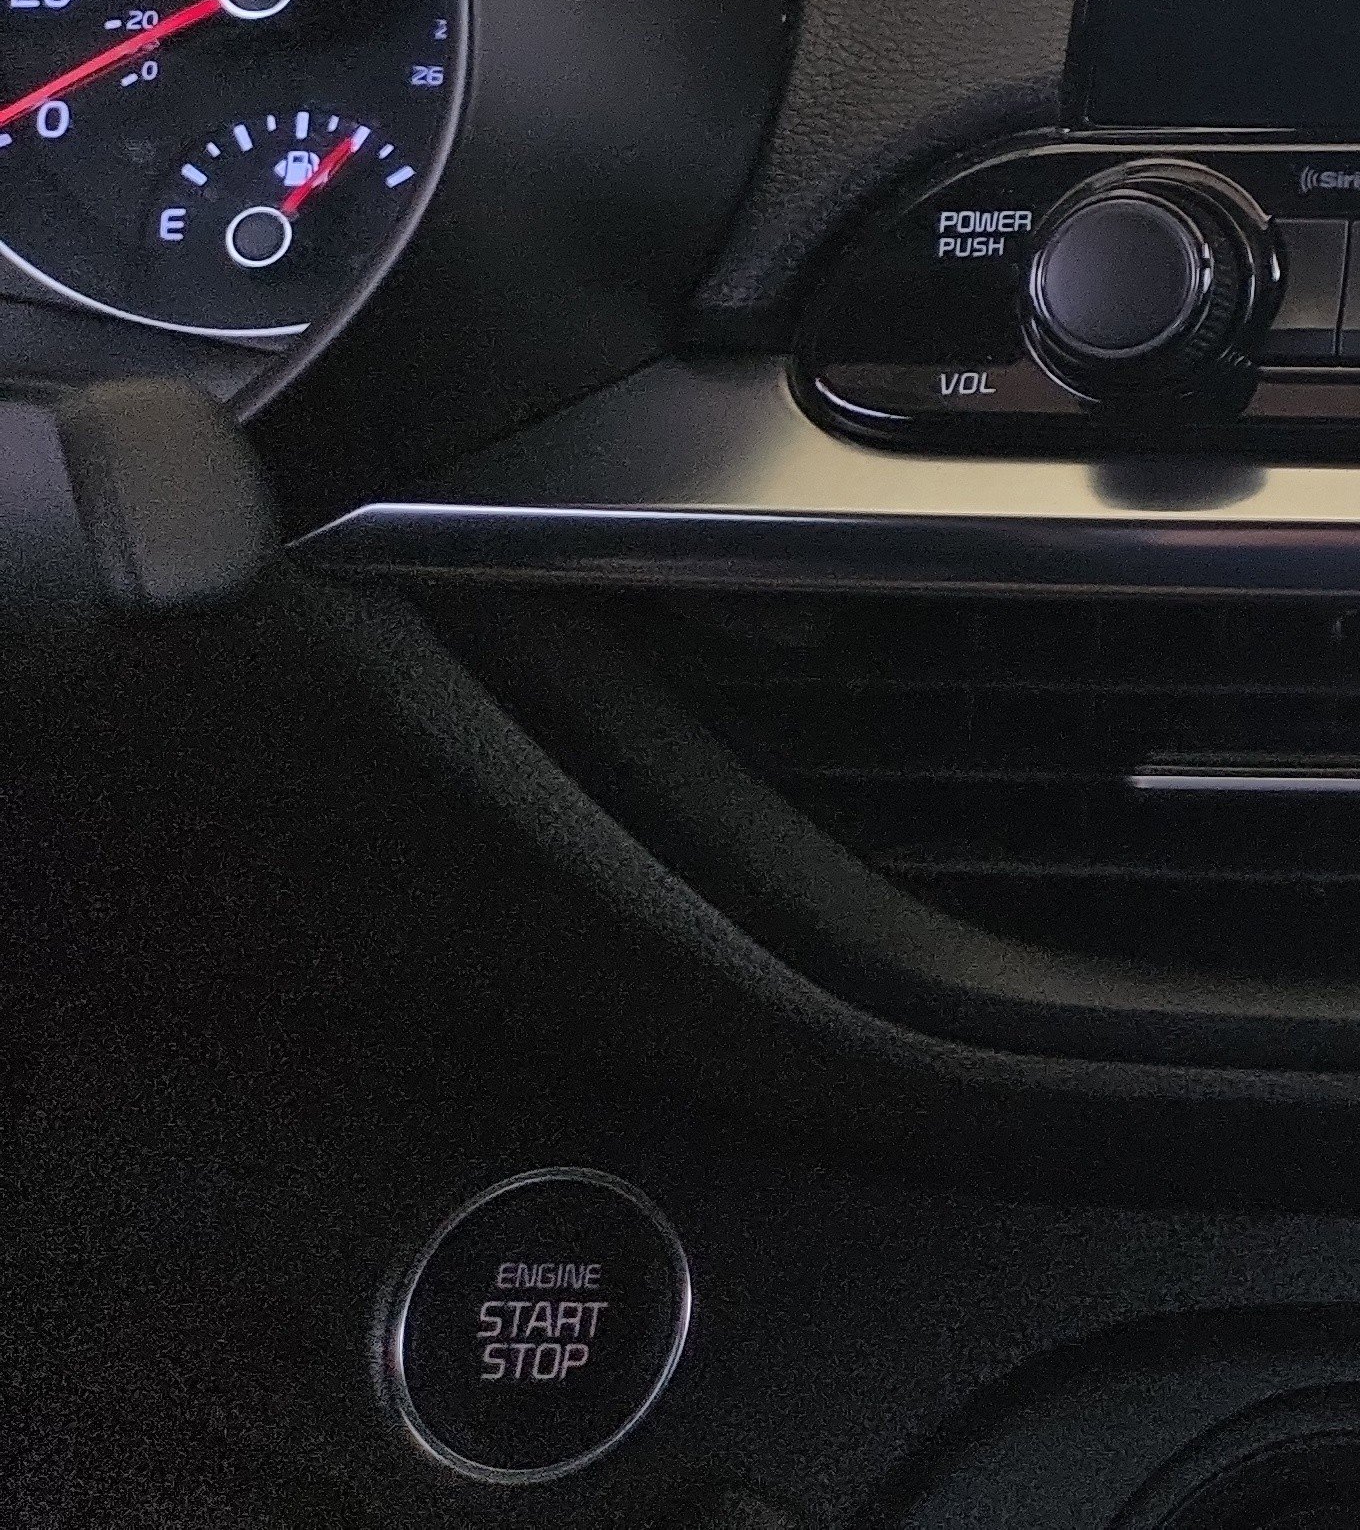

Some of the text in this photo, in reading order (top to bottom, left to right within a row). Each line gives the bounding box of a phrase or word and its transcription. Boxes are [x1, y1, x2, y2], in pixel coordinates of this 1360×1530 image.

[126, 10, 159, 30] 20
[140, 60, 158, 81] 0
[410, 65, 444, 85] 26
[36, 100, 71, 139] 0
[159, 208, 186, 241] E
[939, 210, 1032, 234] POWER
[938, 236, 1005, 257] PUSH
[940, 372, 996, 395] VOL
[498, 1262, 601, 1288] ENGINE
[476, 1300, 609, 1338] START
[480, 1342, 590, 1380] STOP
